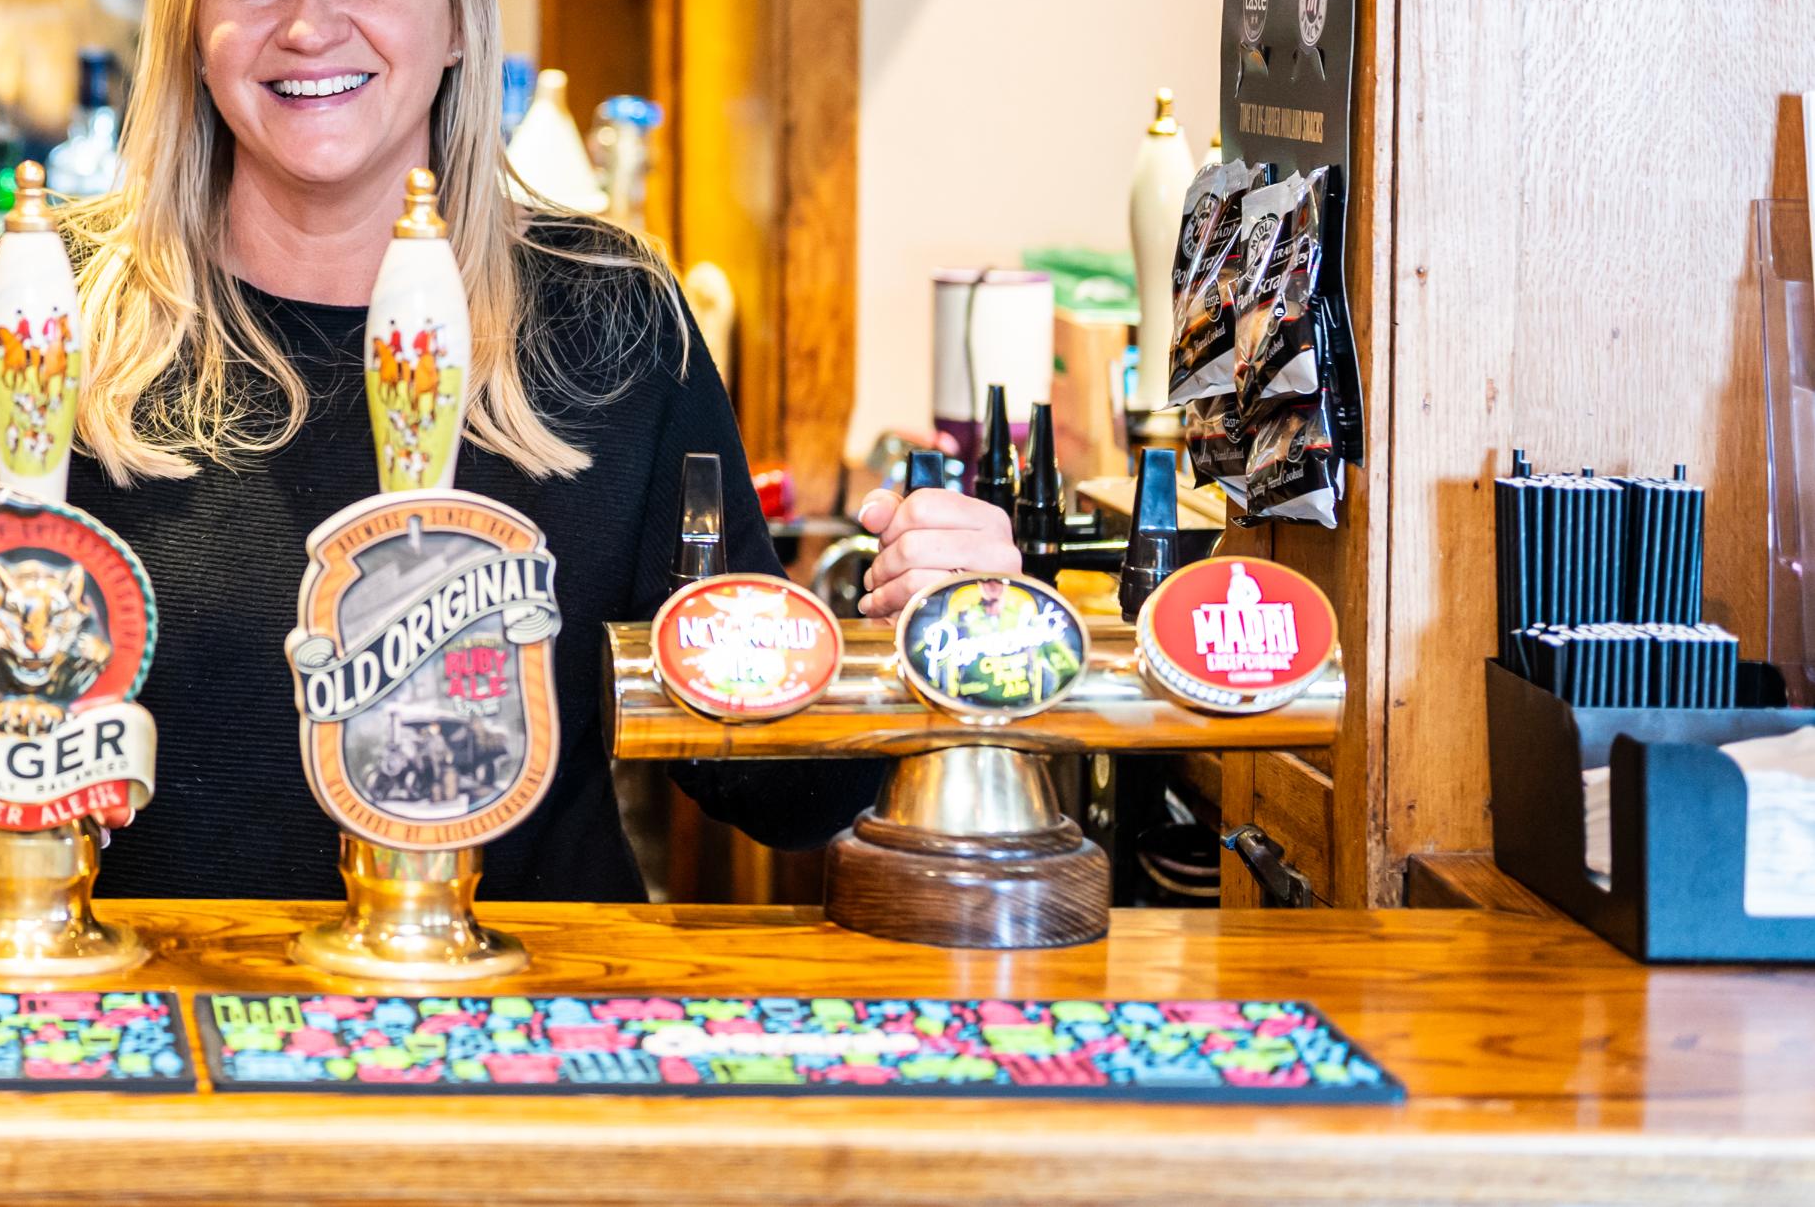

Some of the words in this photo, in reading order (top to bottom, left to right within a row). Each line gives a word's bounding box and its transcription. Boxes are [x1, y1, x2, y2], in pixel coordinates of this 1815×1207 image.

[307, 649, 382, 718] OLD
[382, 557, 549, 681] ORIGINAL
[443, 645, 509, 680] RUBY
[446, 676, 509, 702] ALE
[40, 794, 86, 826] ALE
